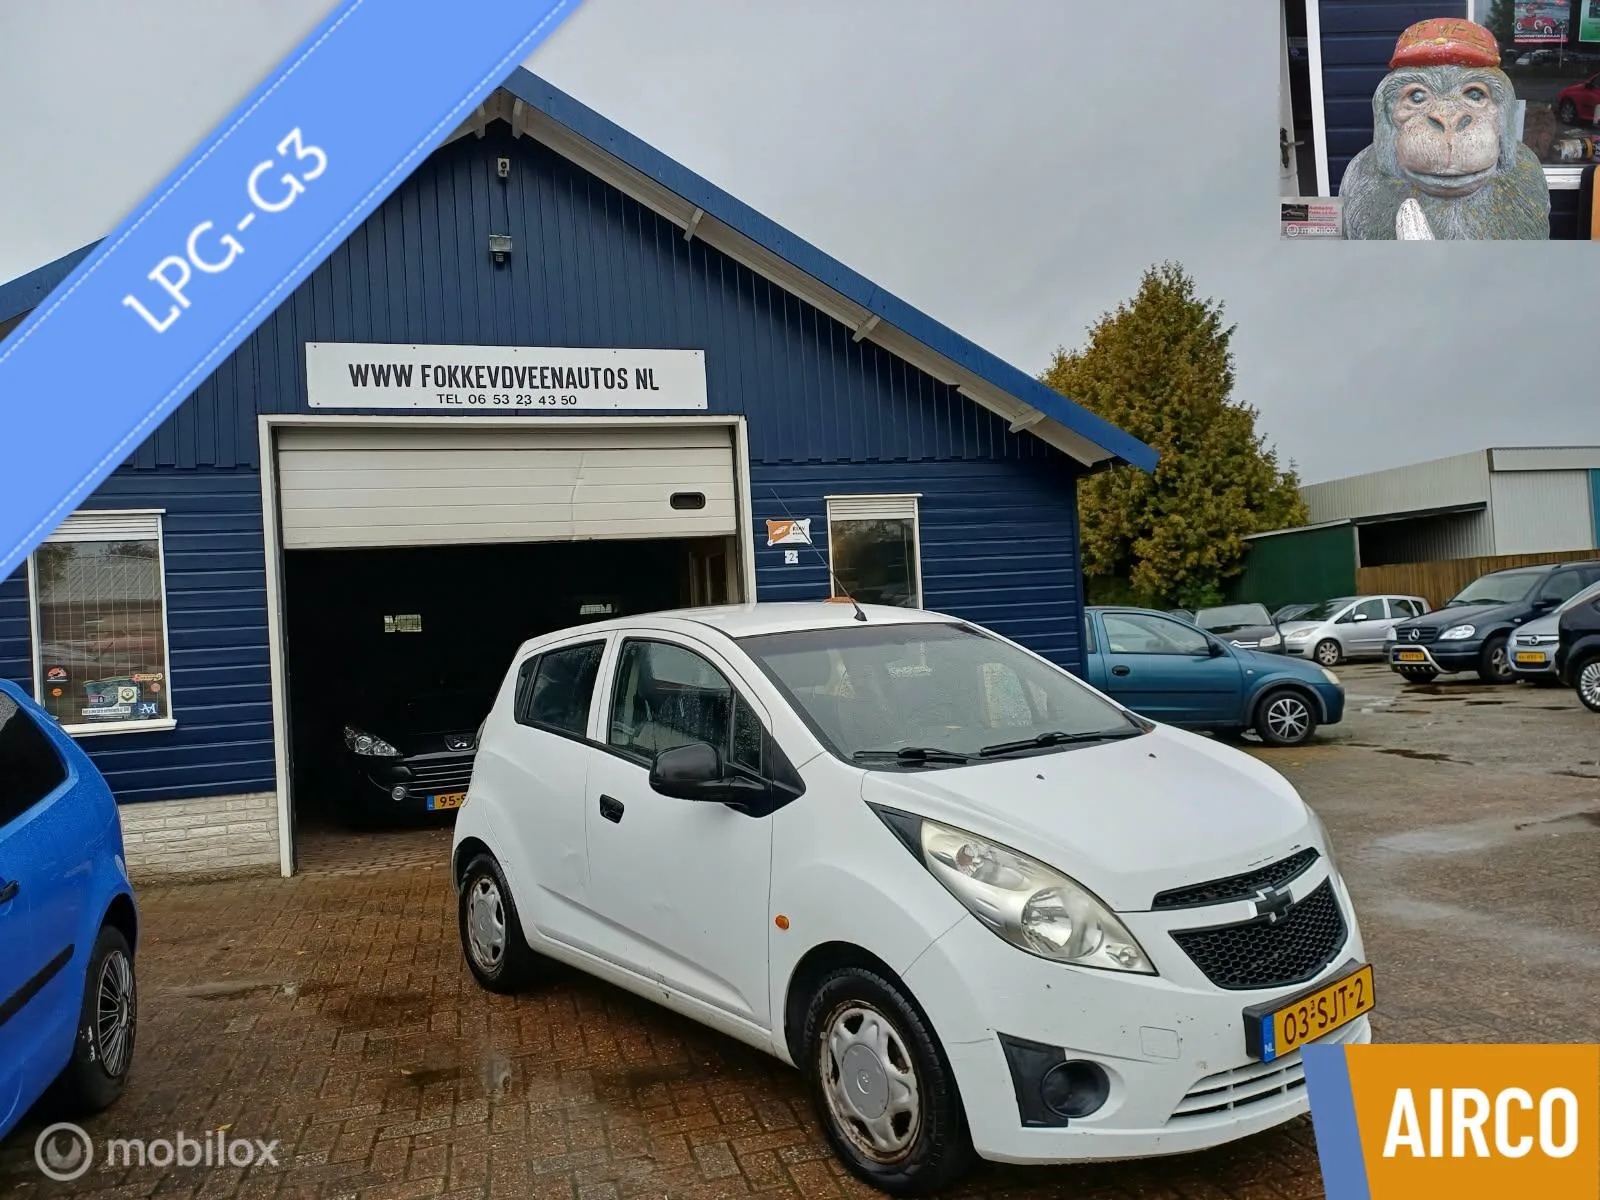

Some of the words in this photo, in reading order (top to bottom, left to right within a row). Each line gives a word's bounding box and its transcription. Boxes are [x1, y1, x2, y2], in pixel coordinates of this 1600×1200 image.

[348, 364, 413, 388] WWW
[421, 365, 629, 390] FOKKEVDVEENAUTOS
[636, 368, 660, 391] NL
[437, 394, 463, 404] TEL
[468, 394, 486, 405] 06
[493, 394, 510, 405] 53
[516, 394, 532, 406] 23
[538, 395, 557, 406] 43
[561, 395, 577, 406] 50
[789, 552, 795, 562] 2
[1284, 977, 1365, 1045] 03-SJT-2
